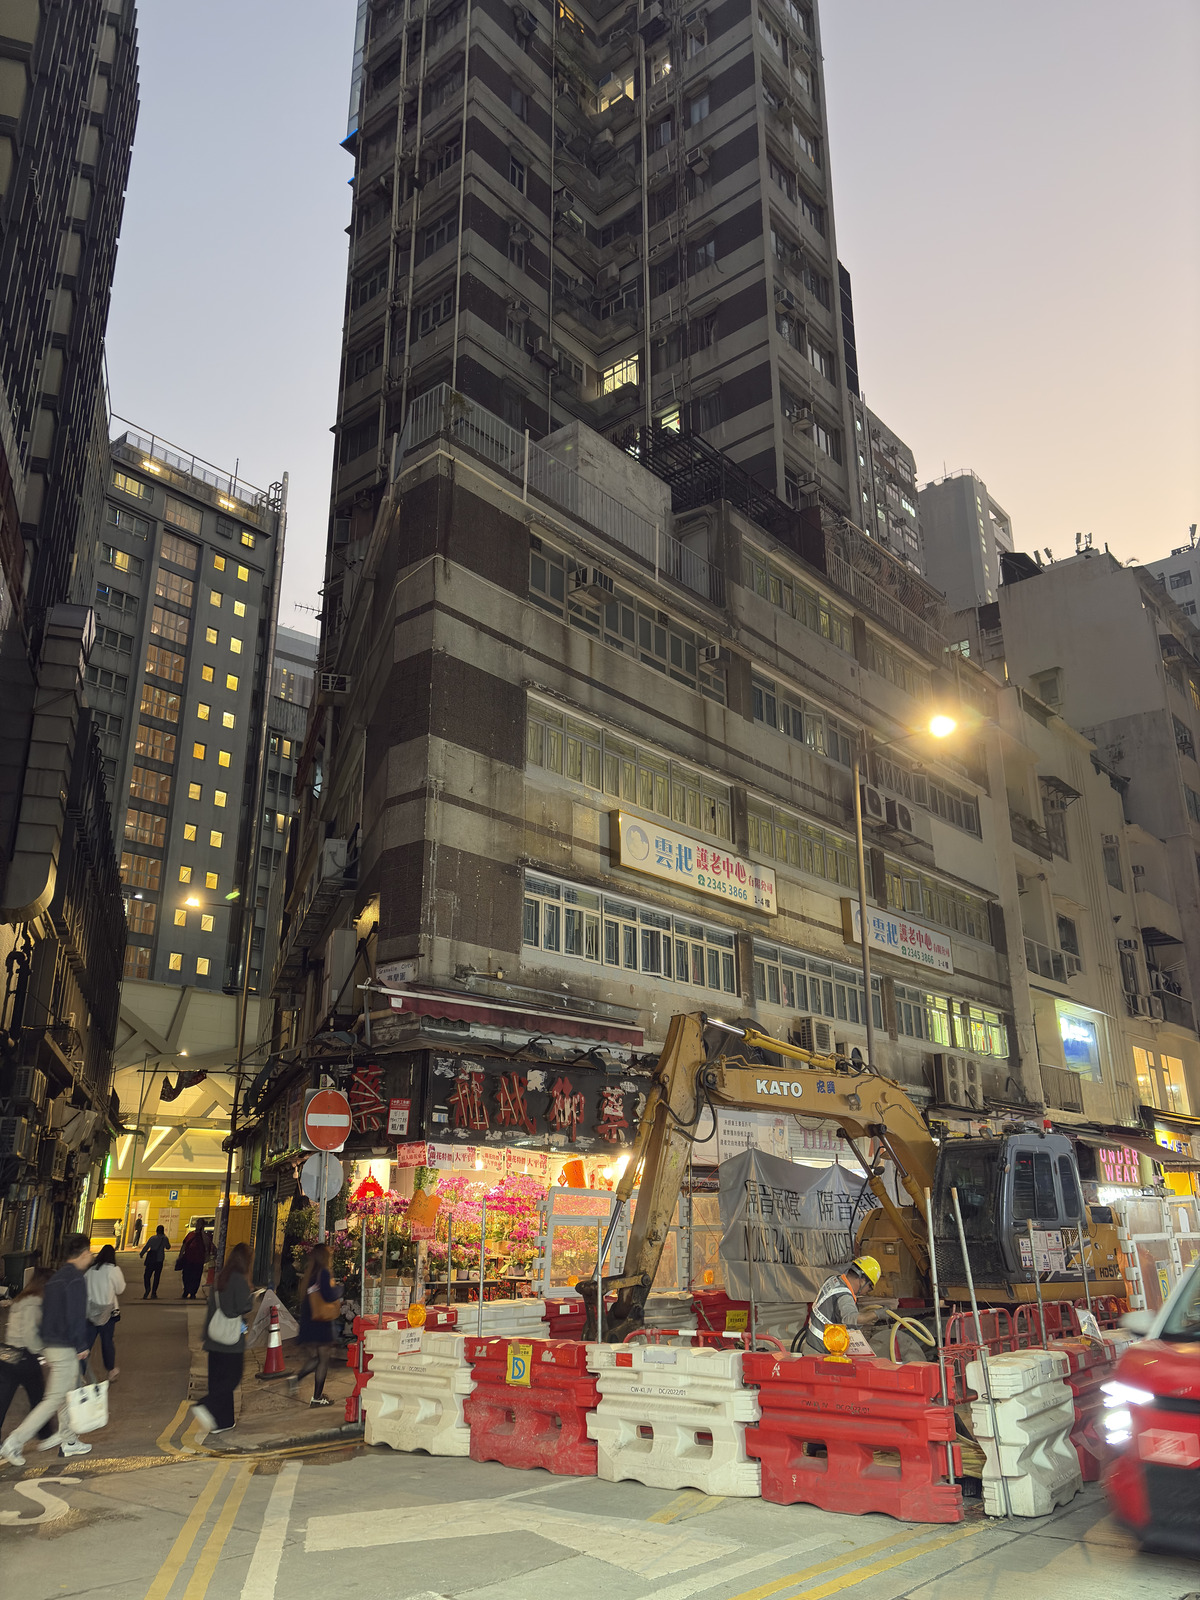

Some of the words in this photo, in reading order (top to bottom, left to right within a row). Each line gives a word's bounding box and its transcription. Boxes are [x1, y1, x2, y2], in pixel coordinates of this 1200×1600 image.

[696, 845, 747, 884] 護老中心
[707, 877, 727, 893] 2345
[728, 884, 748, 900] 3866
[907, 949, 921, 961] 2345
[756, 1079, 803, 1098] KATO
[1099, 1147, 1139, 1166] UNDER
[1104, 1164, 1139, 1183] WEAR
[822, 1232, 850, 1265] NOISE
